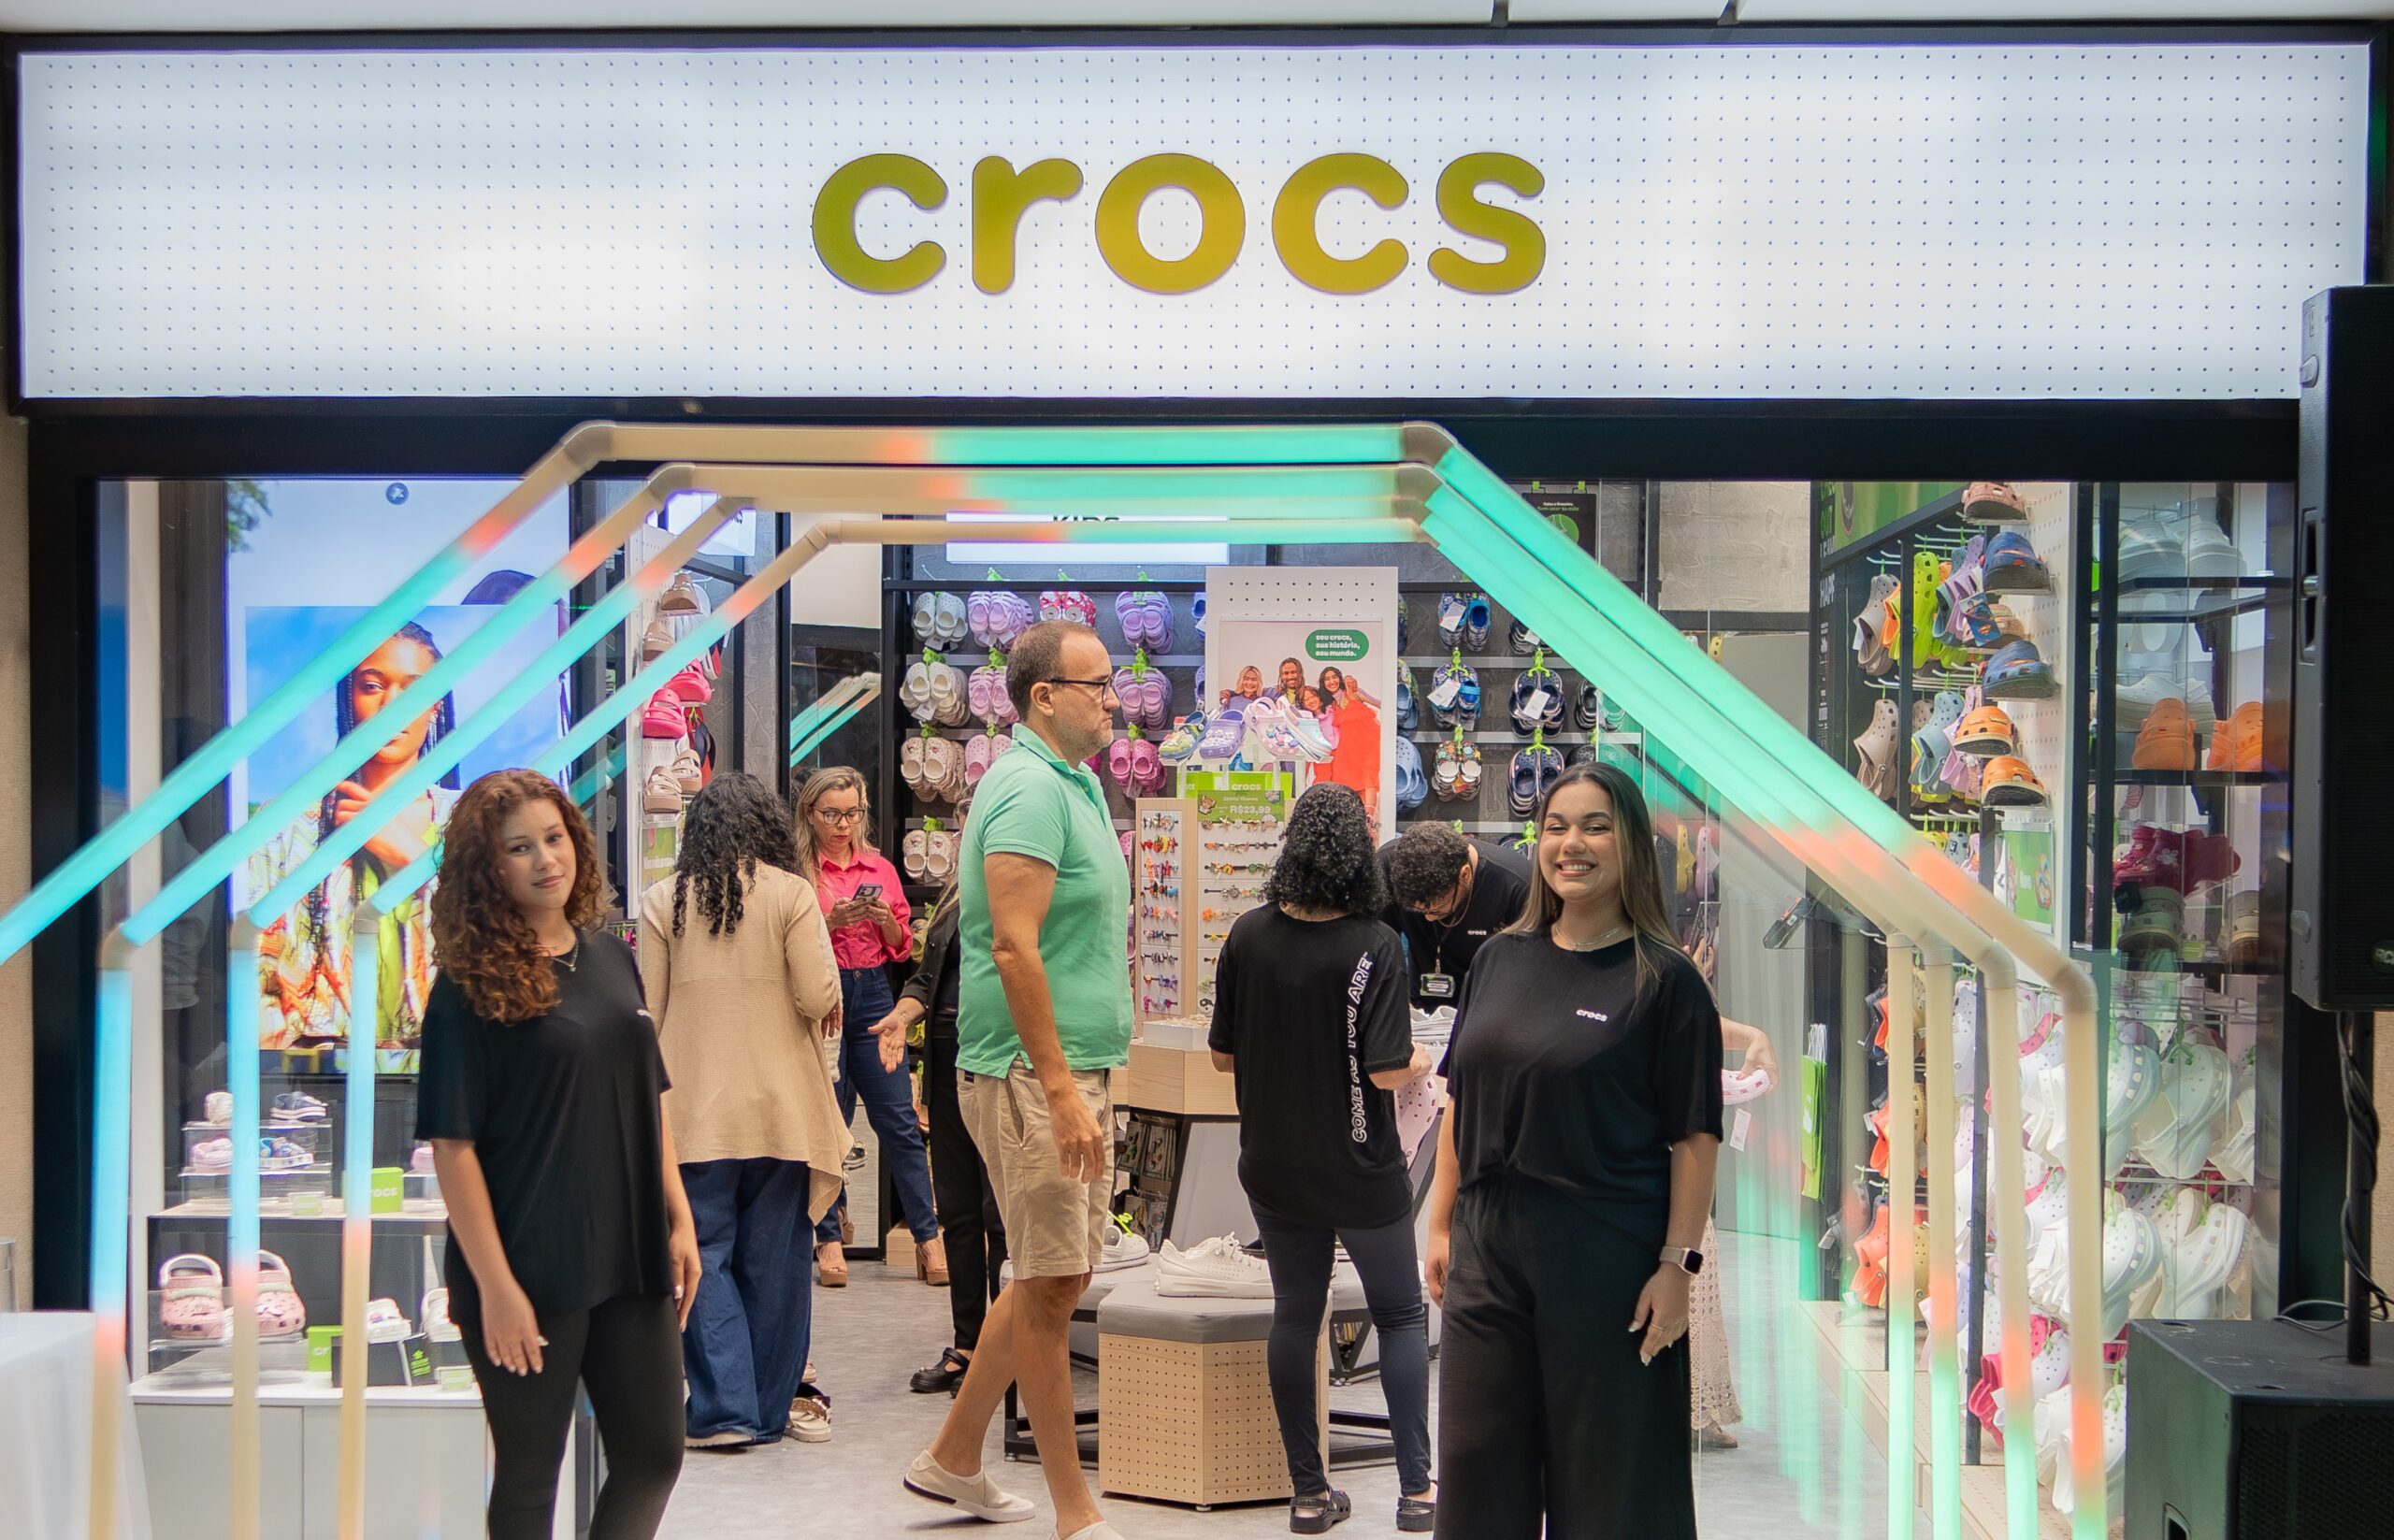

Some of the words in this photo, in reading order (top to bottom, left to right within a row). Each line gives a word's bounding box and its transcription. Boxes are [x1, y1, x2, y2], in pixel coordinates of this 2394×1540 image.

[812, 152, 1547, 295] crocs
[1329, 649, 1357, 657] mundo.
[1230, 805, 1272, 815] R$23,99
[1575, 1009, 1608, 1022] crocs
[1351, 1085, 1367, 1143] COME
